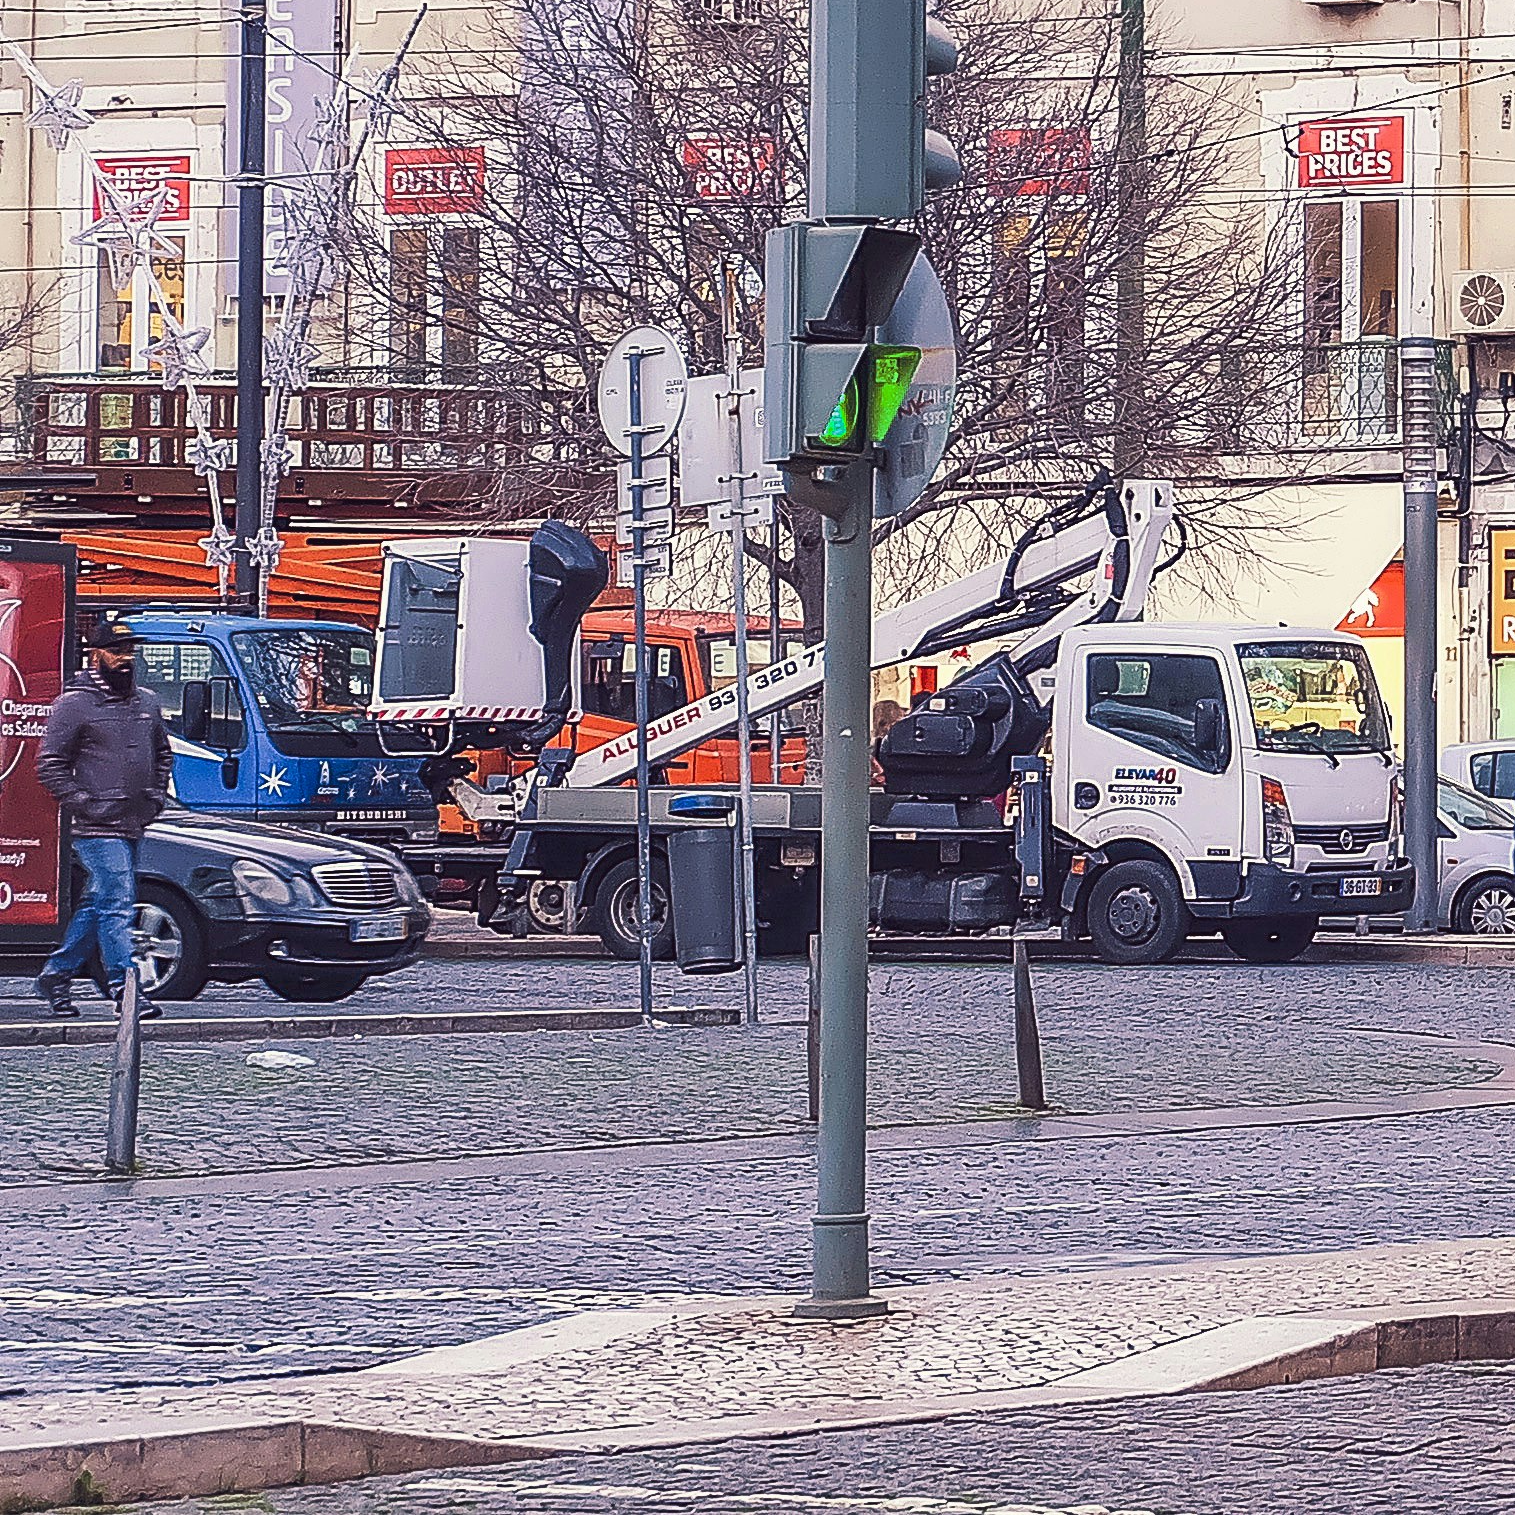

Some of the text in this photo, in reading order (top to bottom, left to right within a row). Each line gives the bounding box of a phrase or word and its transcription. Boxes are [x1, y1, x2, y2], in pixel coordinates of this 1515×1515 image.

[1320, 127, 1380, 153] BEST
[1308, 150, 1392, 178] PRICES
[115, 167, 170, 189] BEST
[754, 659, 798, 690] 320
[2, 699, 54, 720] Chegaram
[2, 723, 14, 736] os
[1118, 794, 1176, 806] 936 320 776
[337, 811, 407, 820] MITSUBISHI
